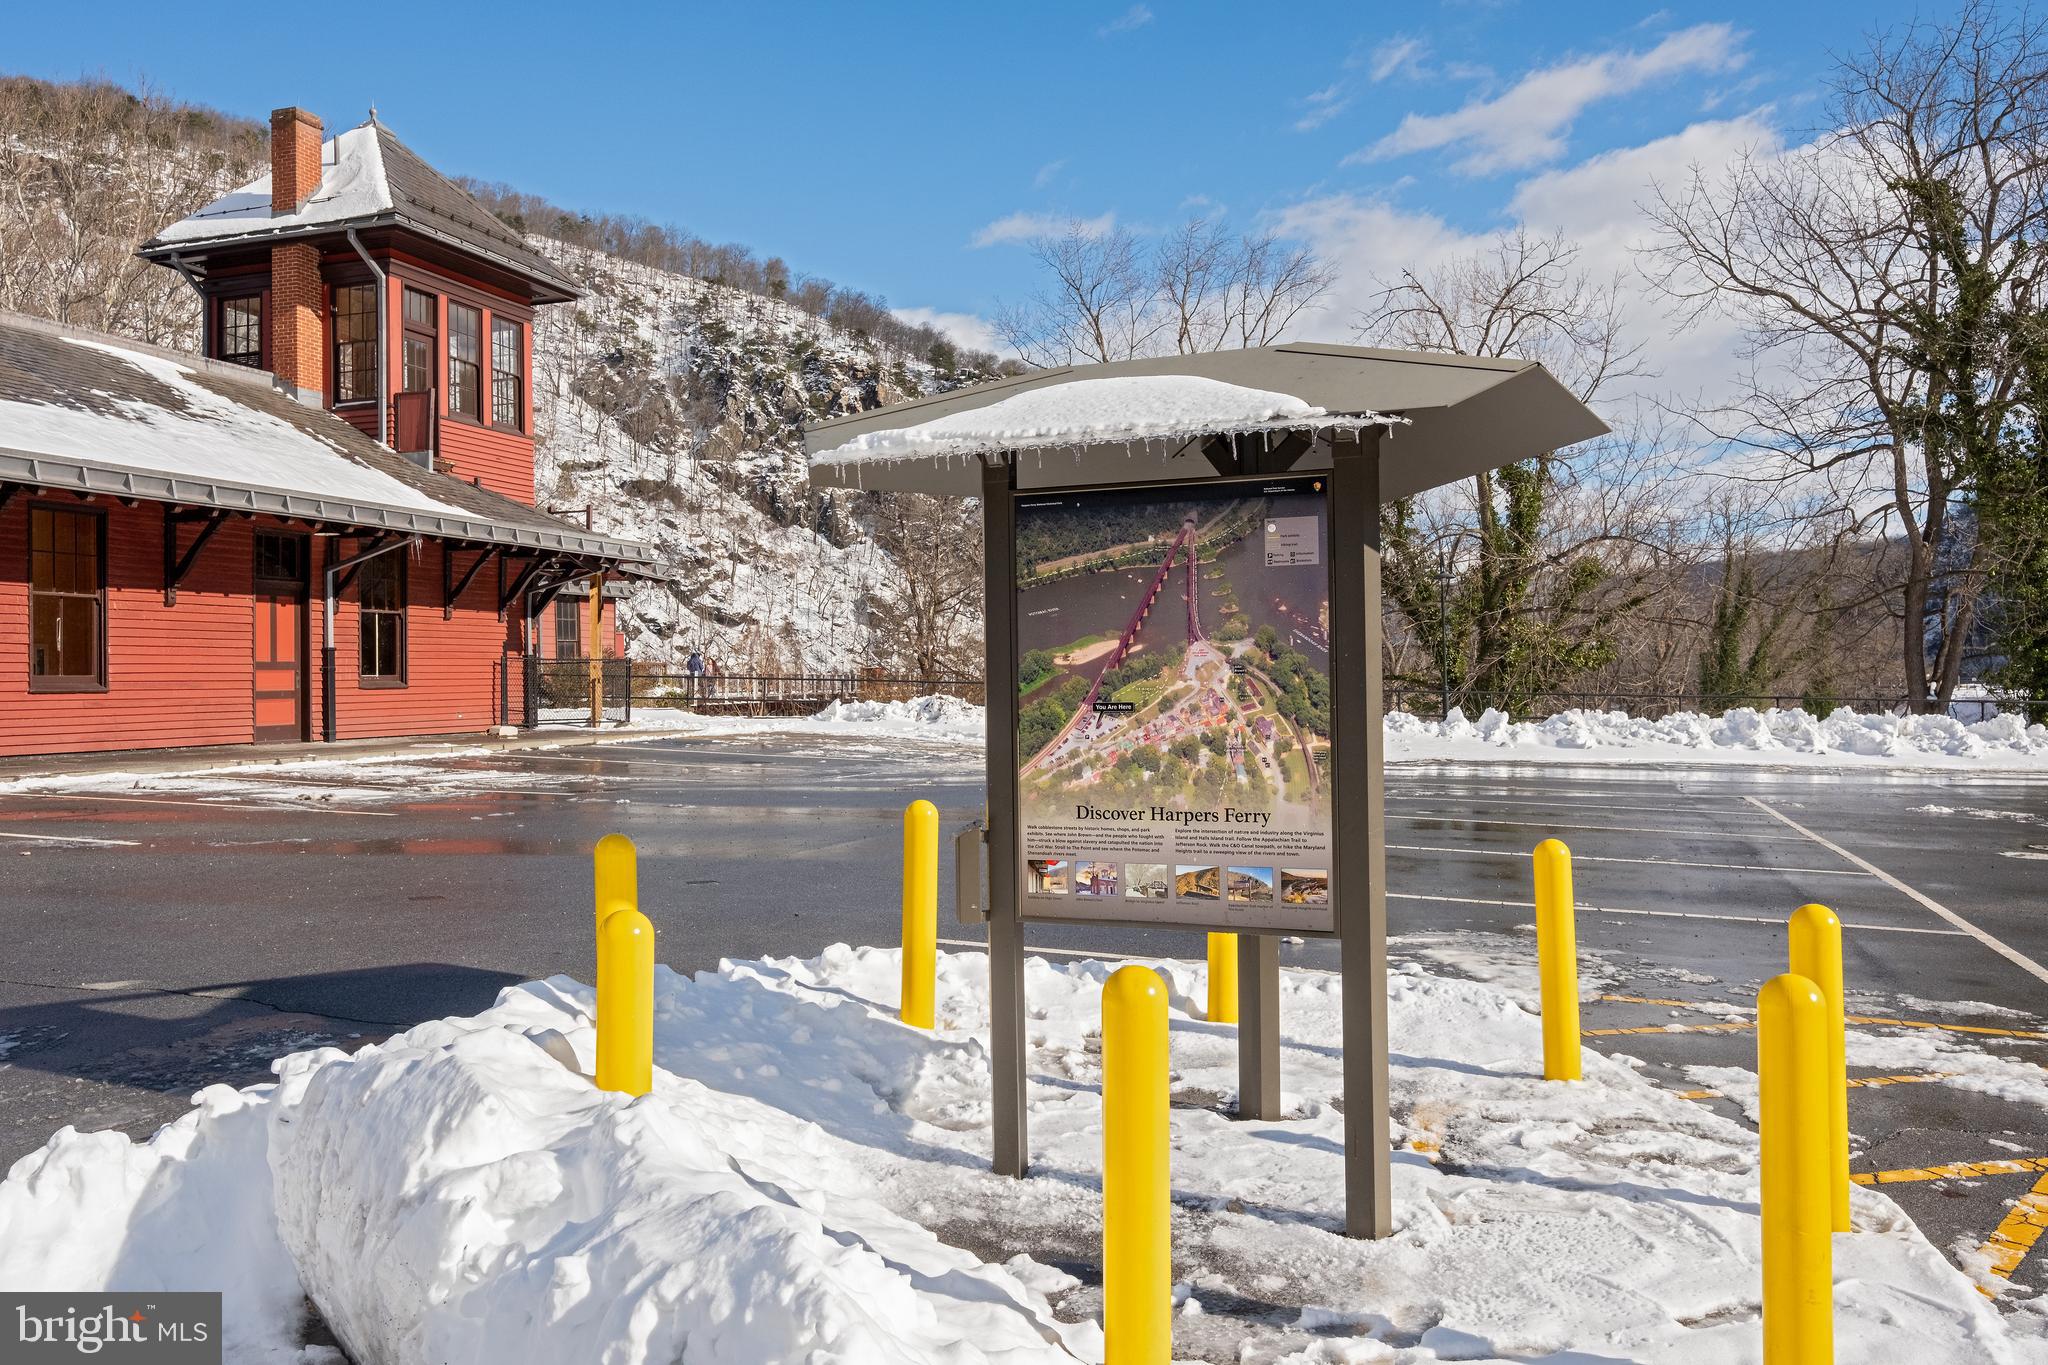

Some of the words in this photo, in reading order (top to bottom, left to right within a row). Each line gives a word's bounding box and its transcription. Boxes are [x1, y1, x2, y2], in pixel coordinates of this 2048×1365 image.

[1076, 805, 1145, 820] Discover
[1150, 807, 1218, 825] Harpers
[1224, 808, 1271, 827] Ferry
